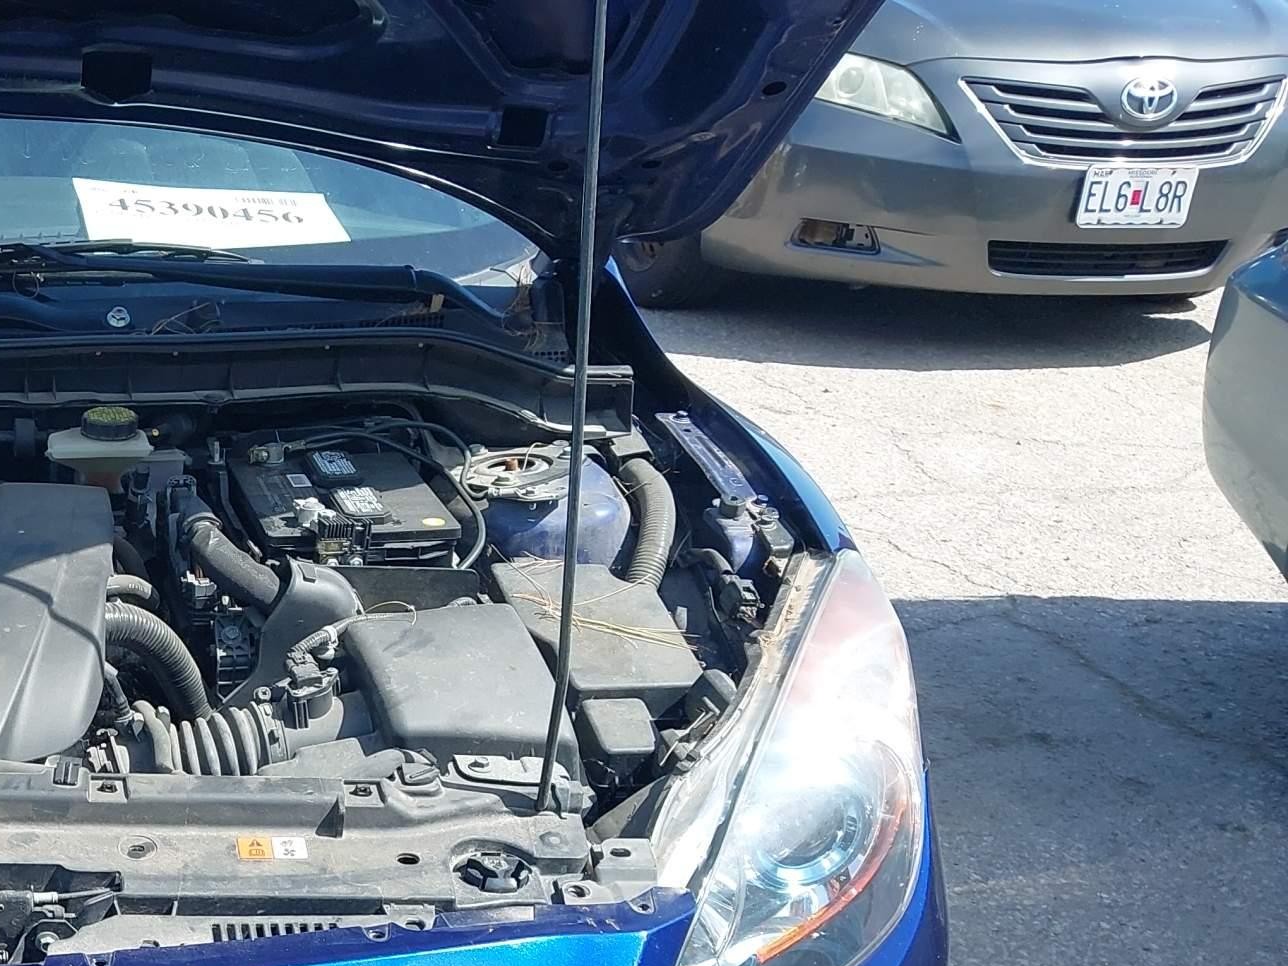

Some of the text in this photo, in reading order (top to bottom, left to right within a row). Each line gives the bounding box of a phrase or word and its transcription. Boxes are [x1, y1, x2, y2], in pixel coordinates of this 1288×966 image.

[109, 197, 304, 224] 45390456
[1084, 180, 1188, 213] EL6 L8R
